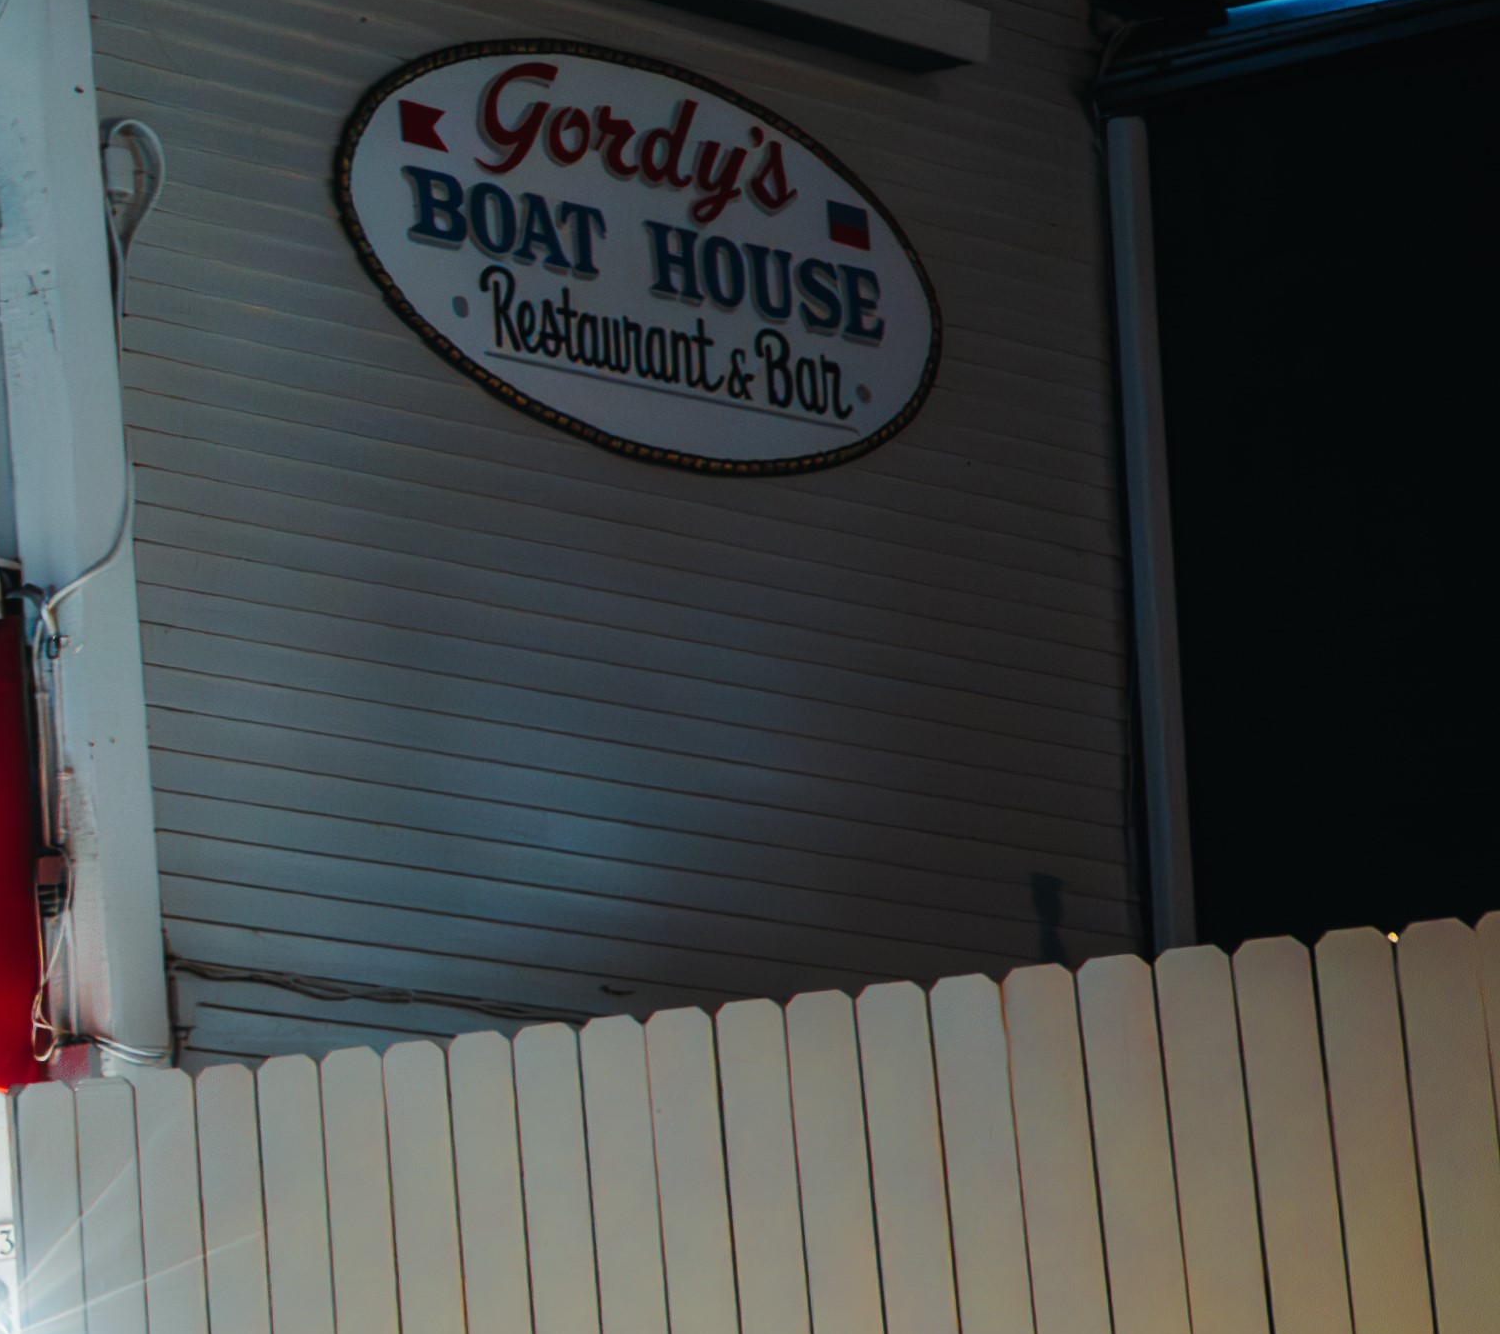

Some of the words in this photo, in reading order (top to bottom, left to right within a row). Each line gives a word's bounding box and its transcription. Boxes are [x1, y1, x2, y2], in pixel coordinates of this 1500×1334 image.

[474, 61, 798, 226] Gordy's
[403, 166, 607, 277] BOAT
[645, 219, 886, 345] HOUSE
[480, 265, 725, 393] Restaurant
[727, 348, 755, 401] &
[755, 328, 853, 419] Bar
